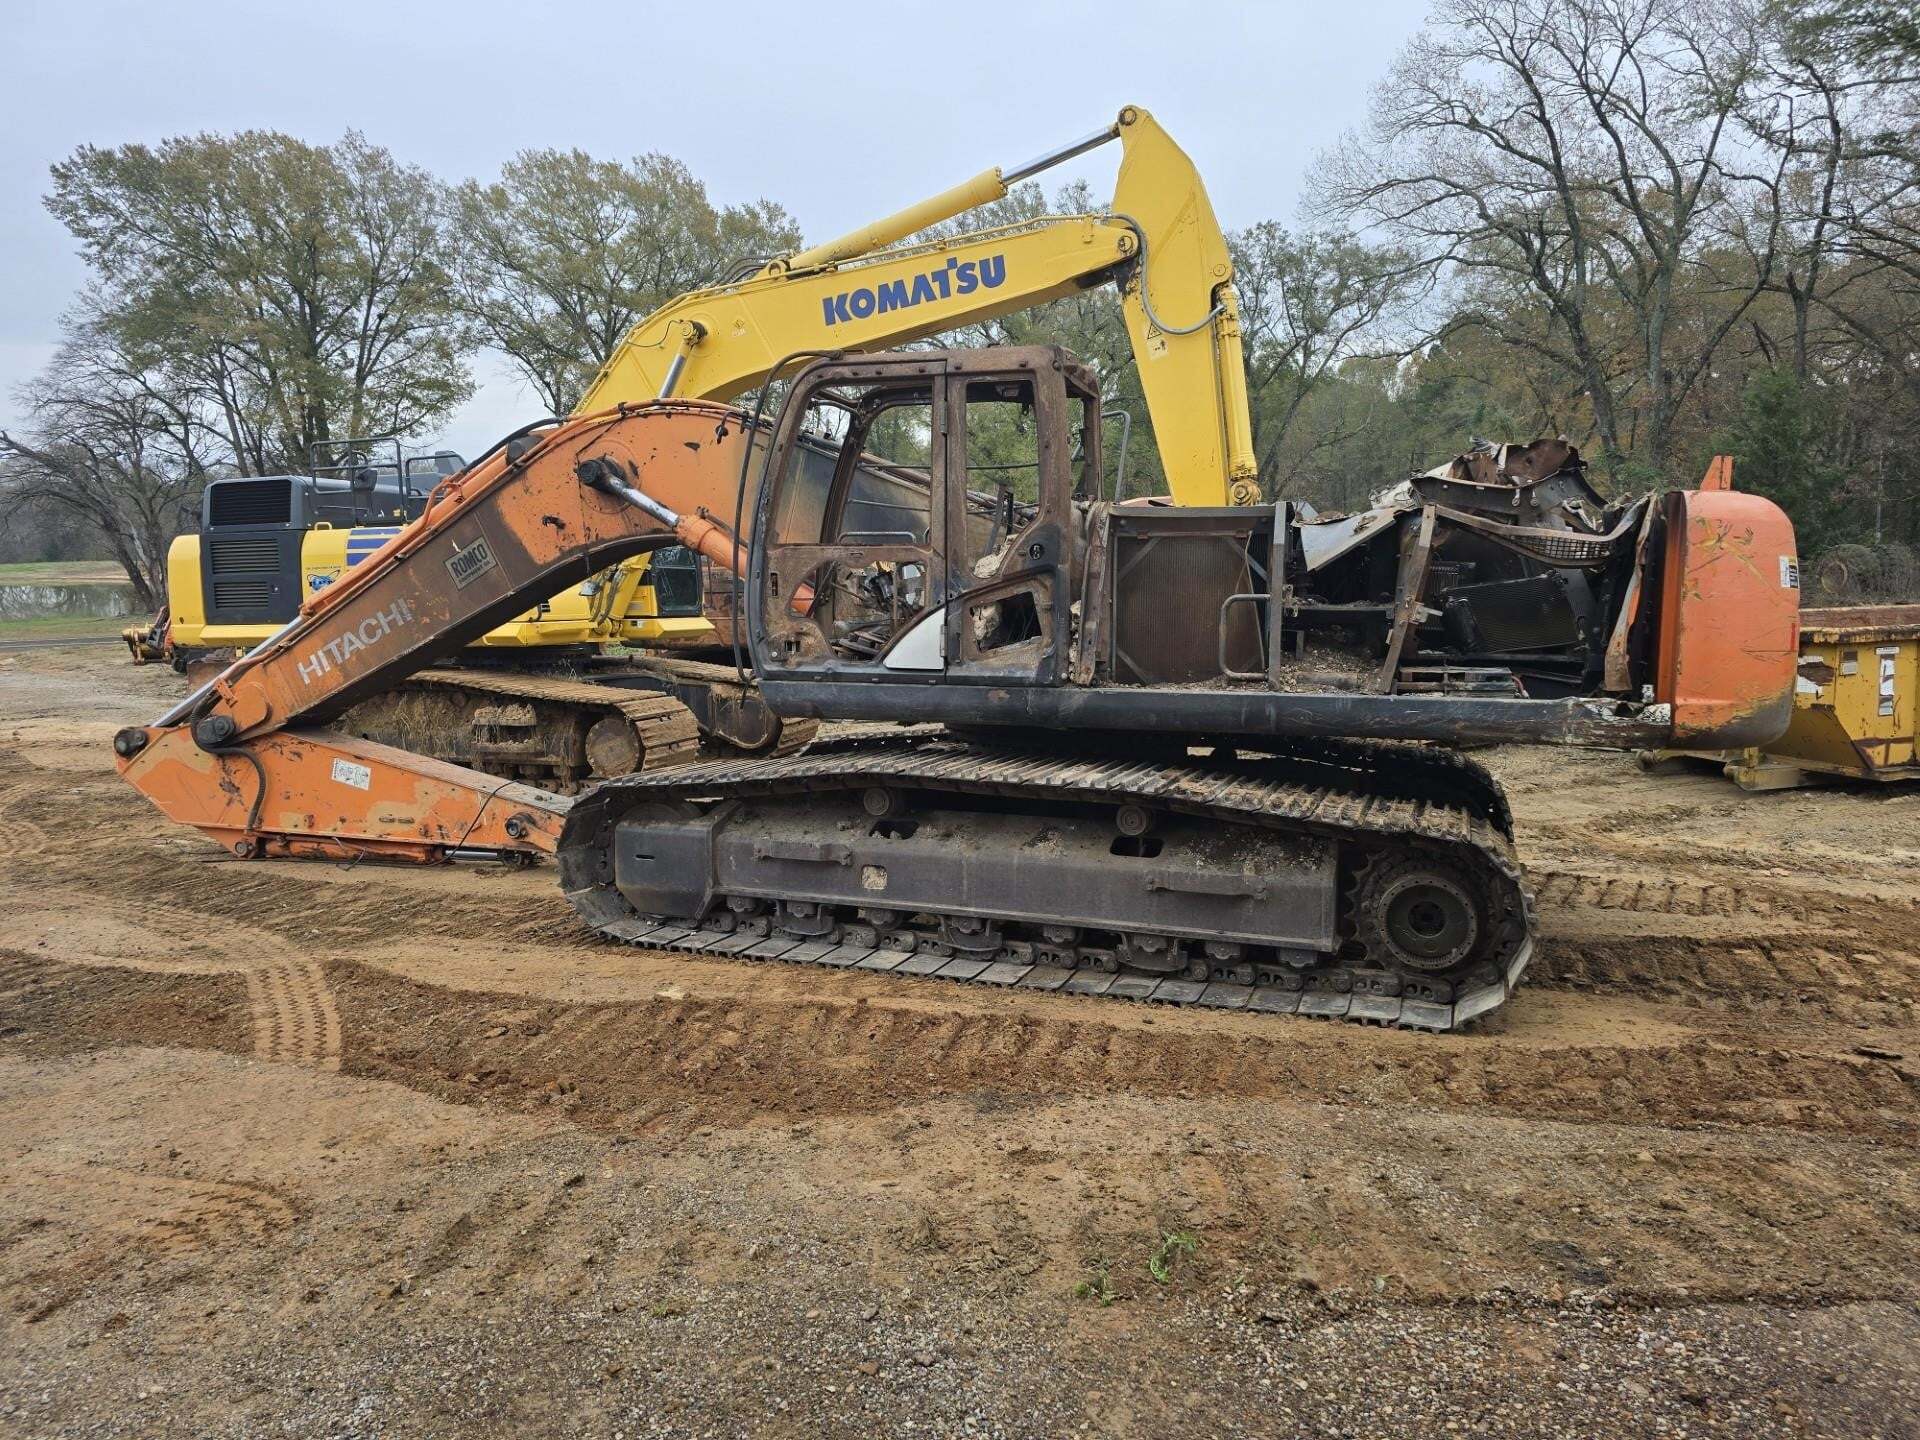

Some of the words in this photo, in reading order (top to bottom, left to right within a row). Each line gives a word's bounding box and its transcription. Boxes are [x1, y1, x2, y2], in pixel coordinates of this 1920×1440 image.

[822, 255, 1006, 326] KOMATSU
[450, 543, 488, 578] ROMCO
[297, 598, 413, 685] HITACHI
